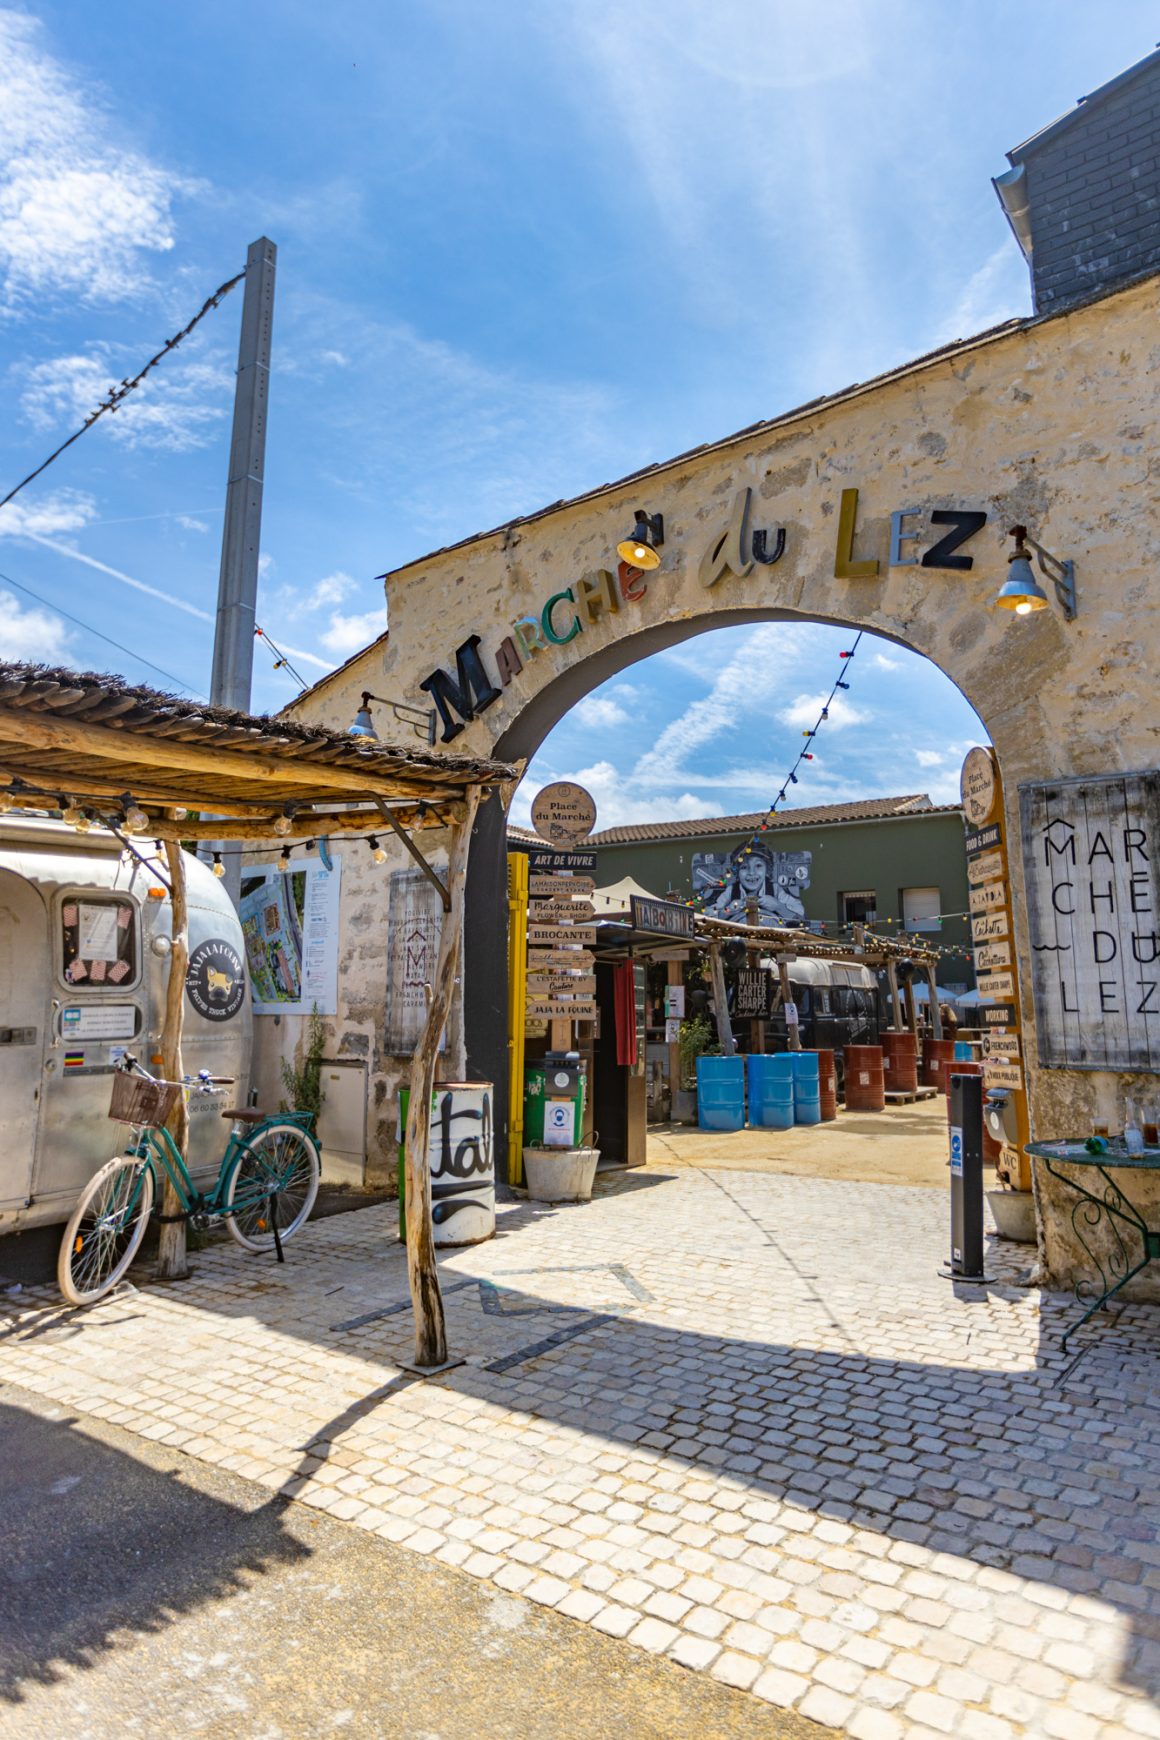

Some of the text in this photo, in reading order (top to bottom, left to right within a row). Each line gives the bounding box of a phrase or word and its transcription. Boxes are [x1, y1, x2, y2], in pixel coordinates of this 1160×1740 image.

[834, 487, 988, 579] LEZ
[550, 802, 577, 810] Place
[536, 812, 591, 820] du Marché
[966, 835, 977, 852] FOOD
[982, 829, 998, 843] DRINK
[1043, 829, 1149, 866] MAR
[534, 855, 594, 865] ART DE VIVRE
[534, 901, 589, 913] Marguerite
[534, 930, 592, 939] BROCANTE
[190, 951, 208, 975] JAJA
[206, 943, 219, 956] LA
[738, 972, 766, 985] WILLIE
[738, 985, 766, 997] CARTER
[1061, 981, 1160, 1014] LEZ
[738, 997, 766, 1009] SHARPE
[985, 1009, 1009, 1022] WORKING
[1003, 1152, 1017, 1170] WC
